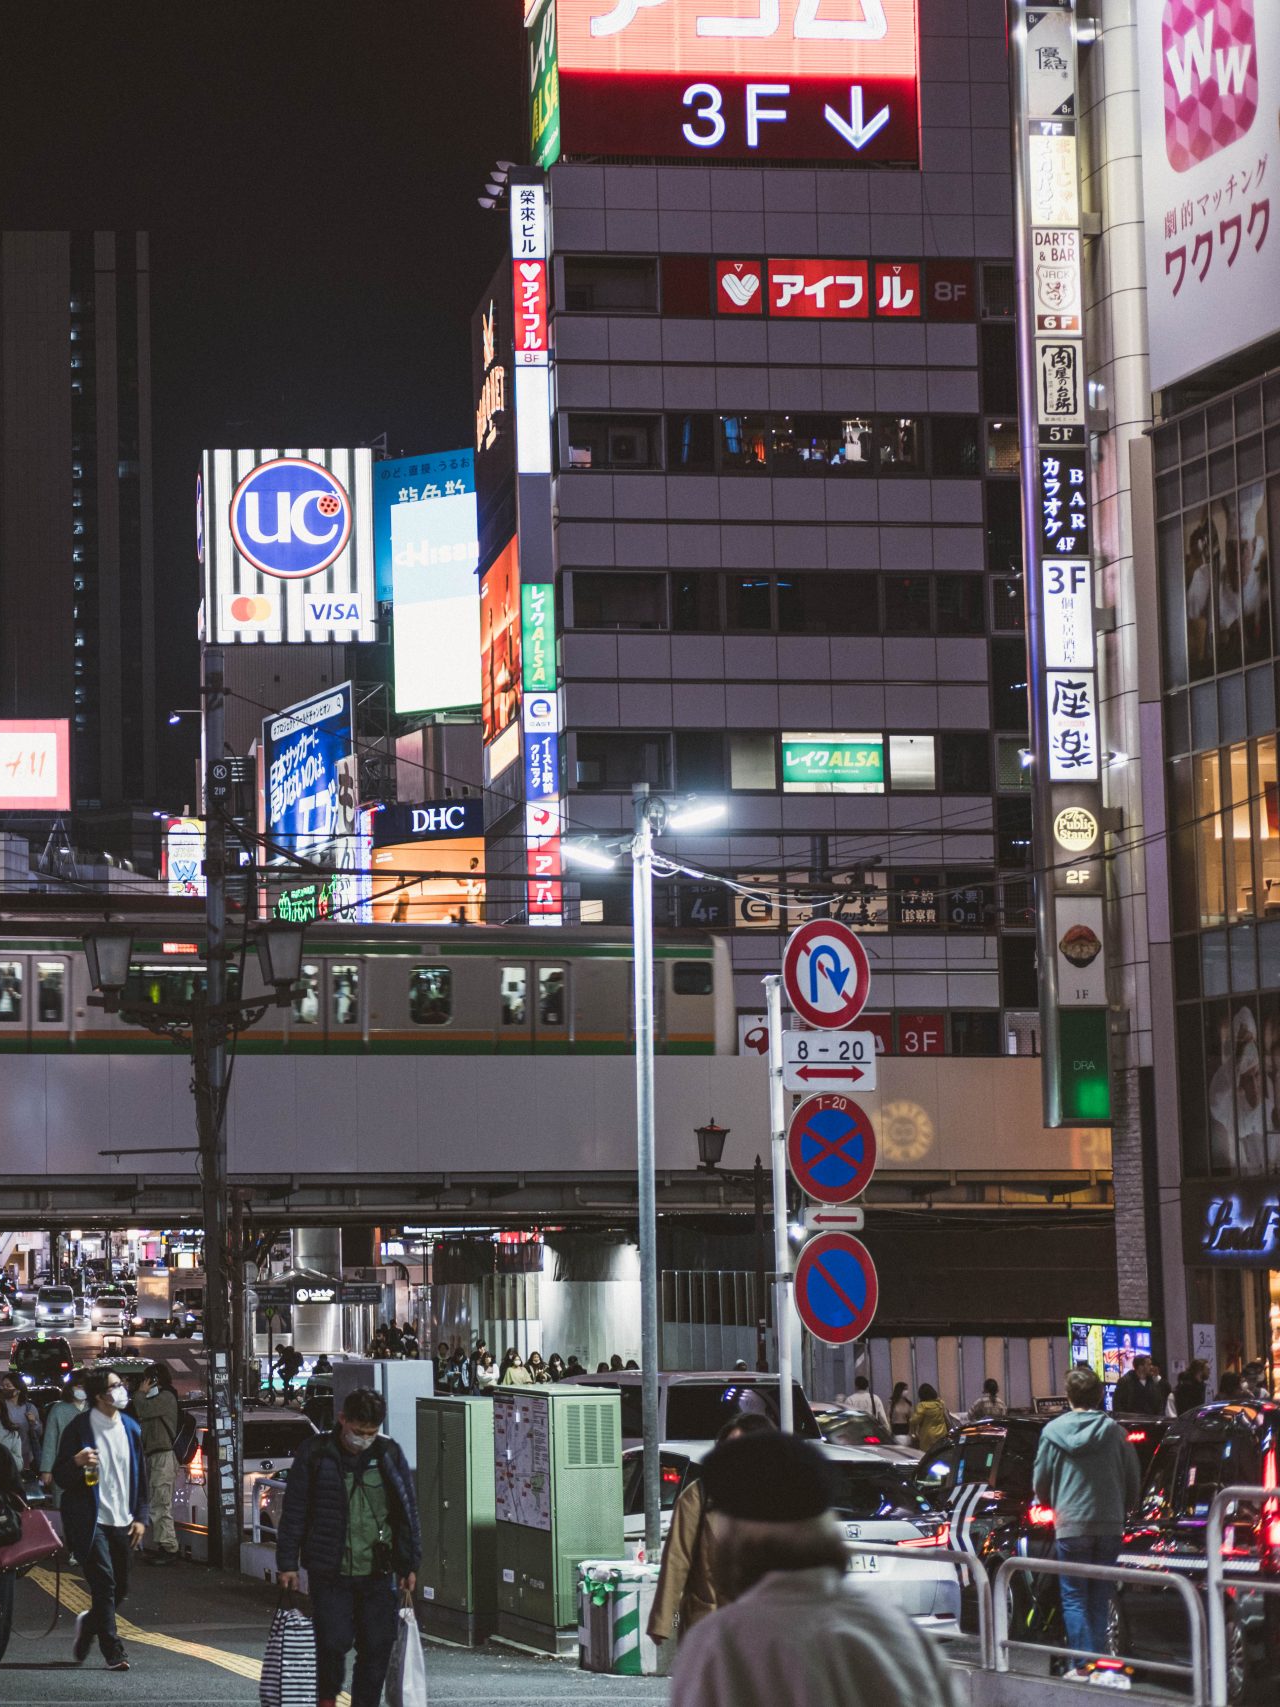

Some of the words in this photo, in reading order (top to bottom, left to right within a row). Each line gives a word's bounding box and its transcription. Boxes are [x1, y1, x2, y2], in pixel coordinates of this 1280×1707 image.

[1040, 121, 1062, 136] 7F
[1164, 153, 1268, 241] 劇的マッチング
[1035, 232, 1075, 246] DARTS
[1051, 248, 1075, 262] BAR
[1165, 197, 1270, 298] ワクワク
[772, 274, 913, 309] アイフル
[934, 282, 966, 301] 8F
[521, 281, 542, 350] アイフル
[1043, 316, 1073, 329] 6F
[524, 354, 539, 363] 8F
[1049, 427, 1073, 441] 5F
[1043, 458, 1062, 537] カラオケ
[1069, 470, 1086, 529] BAR
[1056, 537, 1076, 552] 4F
[1048, 566, 1086, 594] 3F
[310, 603, 360, 620] VISA
[214, 786, 226, 796] ZIP
[412, 806, 465, 832] DHC
[1059, 818, 1095, 830] Public
[1060, 829, 1092, 840] Stand
[1066, 870, 1090, 884] 2F
[691, 901, 719, 921] 4F
[1076, 989, 1089, 999] 1F
[904, 1031, 937, 1052] 3F
[1074, 1061, 1095, 1070] DRA
